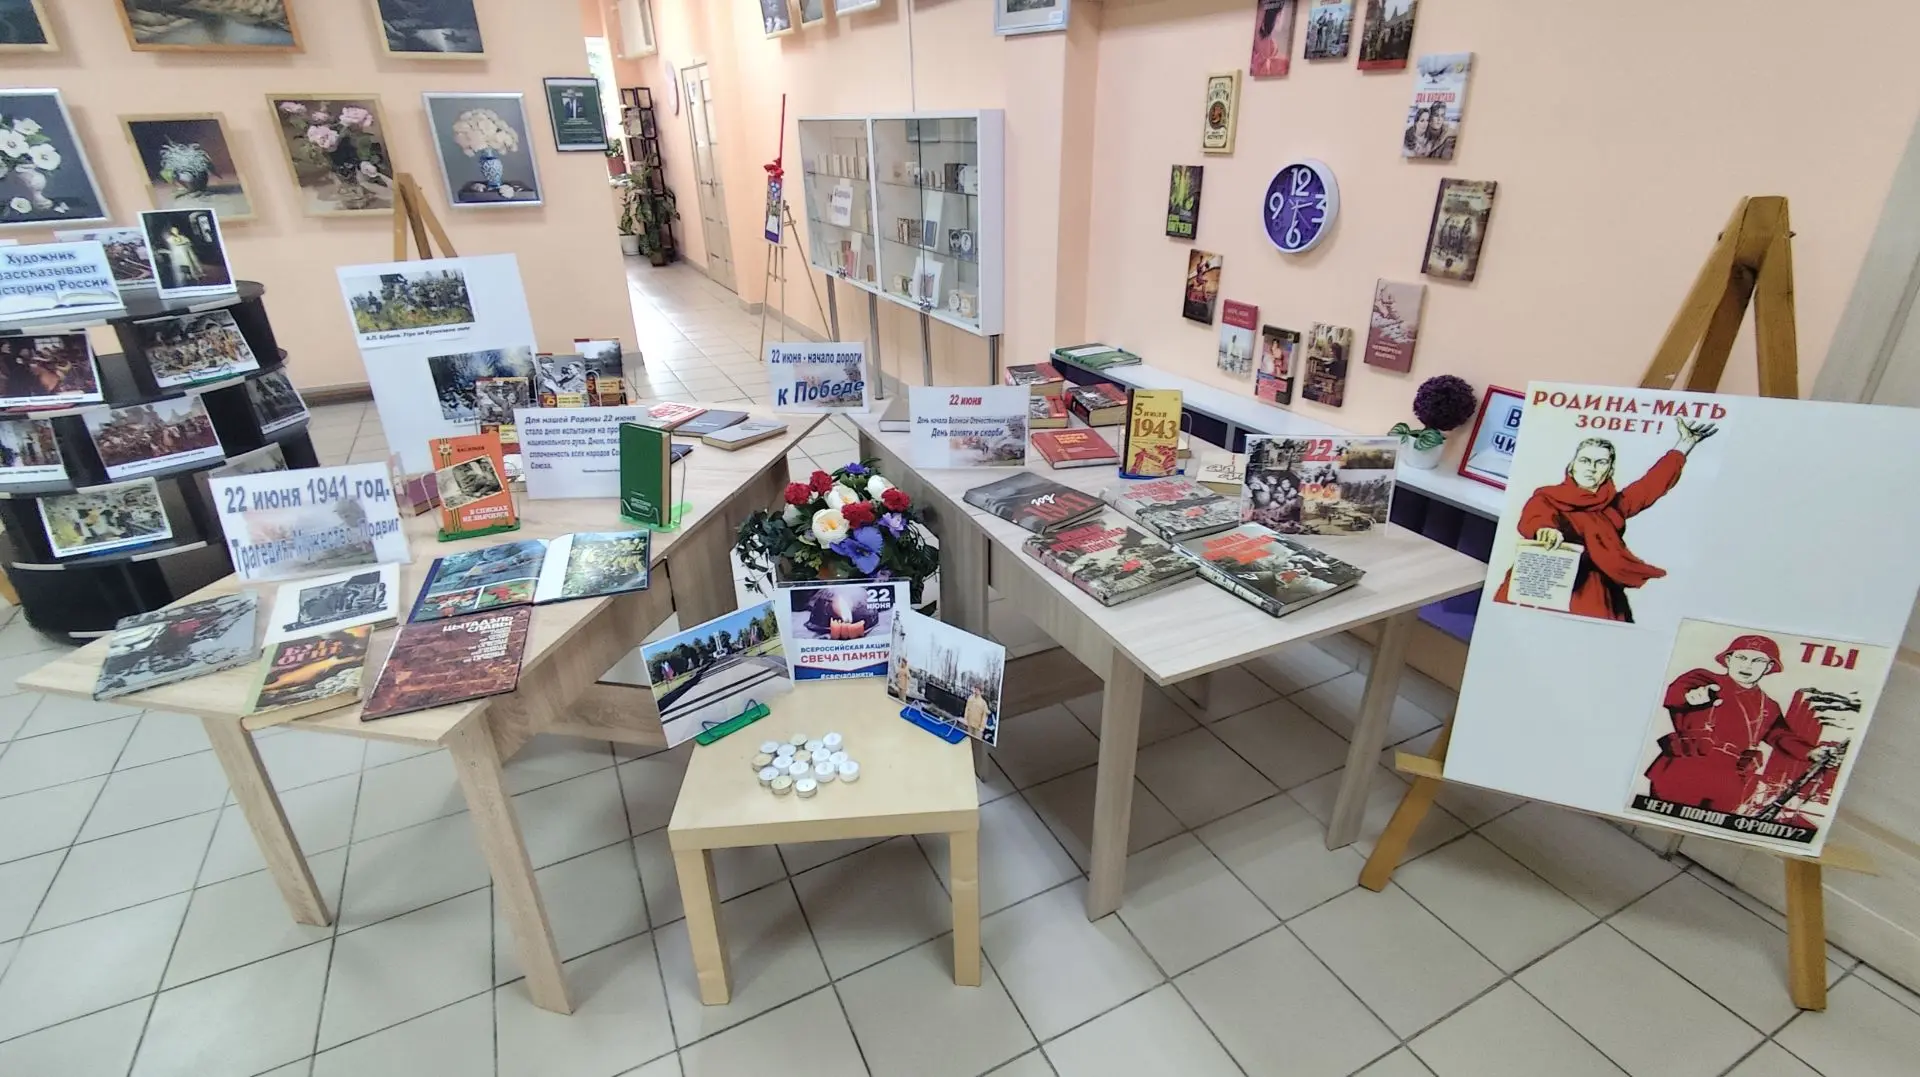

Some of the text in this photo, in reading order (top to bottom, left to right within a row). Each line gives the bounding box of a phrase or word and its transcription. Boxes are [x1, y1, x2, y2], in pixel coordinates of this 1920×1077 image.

[1291, 167, 1312, 196] 12
[1269, 192, 1326, 223] 9 3
[1285, 220, 1301, 248] 6
[6, 251, 76, 265] Художник
[57, 278, 109, 291] России
[771, 349, 780, 364] 22
[782, 353, 802, 363] июня
[808, 353, 835, 363] начало
[836, 352, 862, 364] дороги
[794, 380, 865, 403] Победе
[949, 394, 982, 406] 22 июня
[1134, 403, 1144, 416] 5
[1532, 390, 1727, 420] РОДИНА-МАТЬ
[524, 416, 540, 424] Для
[542, 415, 568, 423] нашей
[603, 414, 613, 422] 22
[1506, 408, 1522, 428] В
[1575, 414, 1664, 435] ЗОВЕТ!
[525, 428, 543, 436] стало
[562, 427, 596, 435] испытания
[606, 426, 619, 436] про
[931, 427, 948, 438] День
[980, 427, 1004, 437] скорби
[1133, 418, 1177, 439] 1943
[1494, 434, 1516, 453] ЧИ
[530, 461, 553, 469] Союза.
[225, 475, 391, 514] 22 июня 1941 год.
[358, 517, 400, 542] Подвиг
[866, 588, 891, 602] 22
[866, 602, 891, 610] ИЮНЯ
[800, 644, 864, 653] ВСЕРОССИЙСКАЯ
[1800, 642, 1860, 670] ТЫ
[800, 651, 890, 664] СВЕЧА ПАМЯТИ
[1643, 797, 1807, 840] ЧЕМ ПОМОГ ФРОНТУ?
